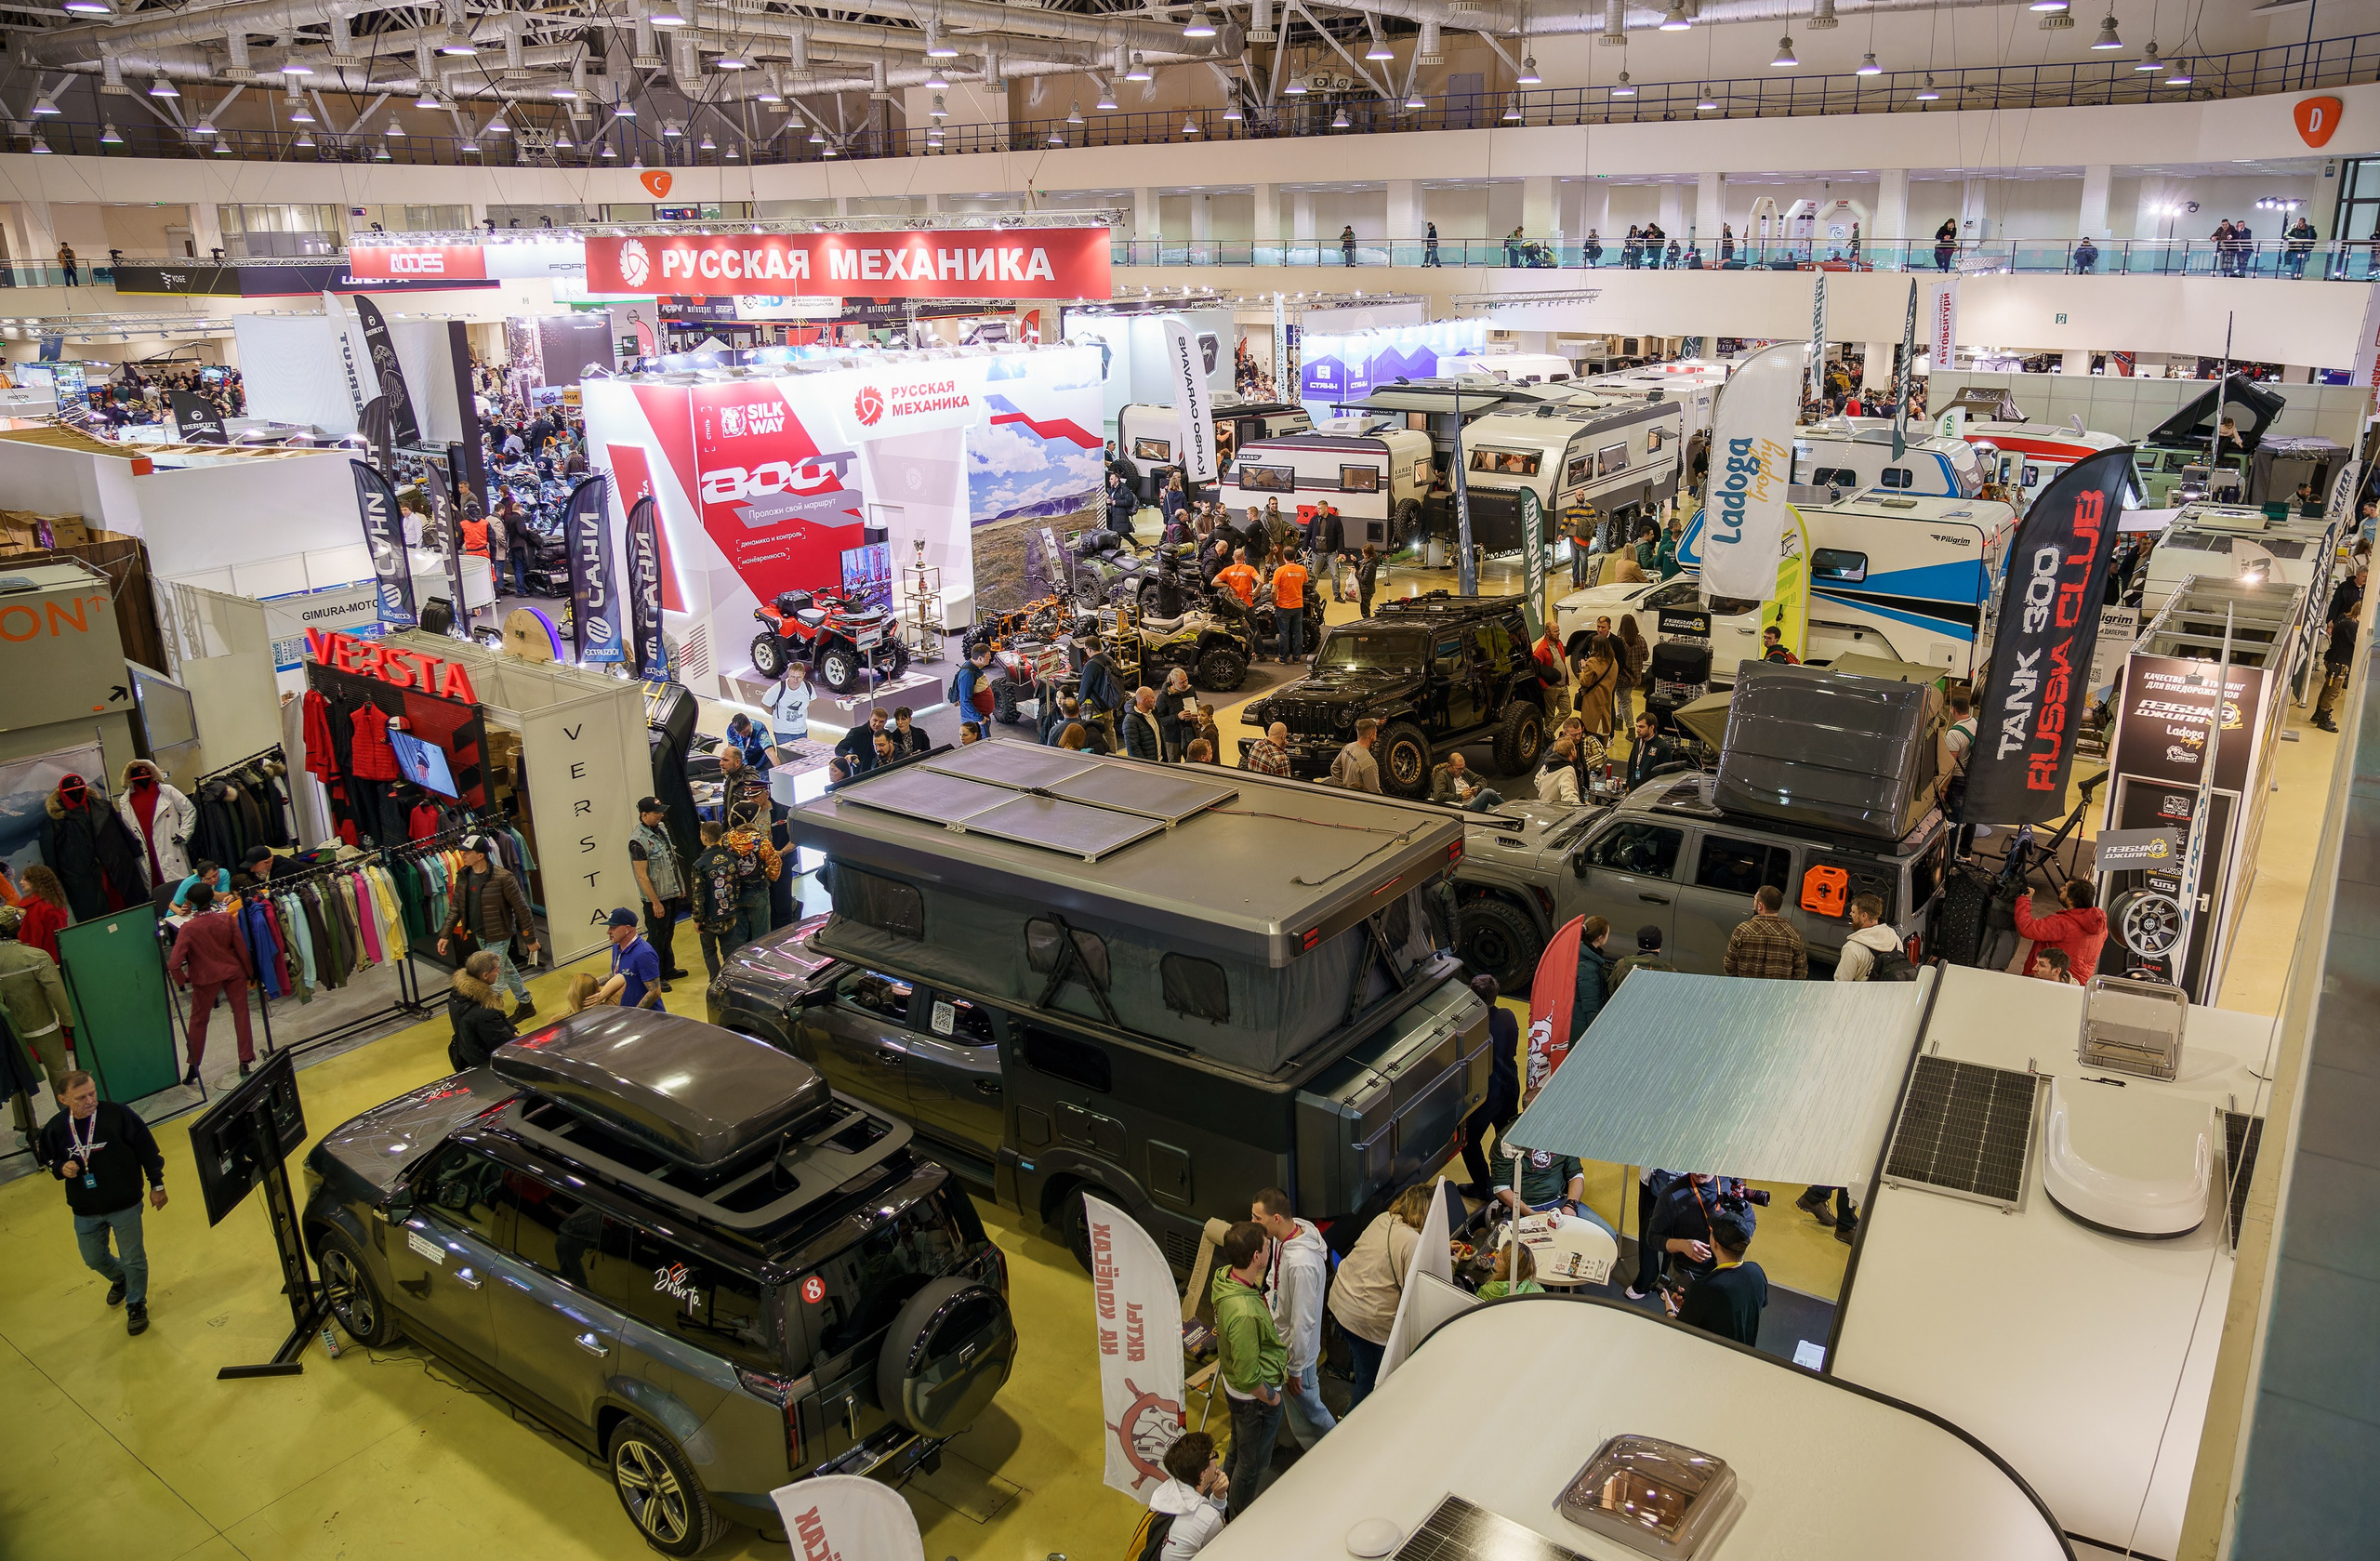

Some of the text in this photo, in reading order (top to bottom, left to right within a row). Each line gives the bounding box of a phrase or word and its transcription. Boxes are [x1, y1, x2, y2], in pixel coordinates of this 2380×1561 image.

[2309, 108, 2323, 132] D
[661, 247, 1055, 282] РУССКАЯ МЕХАНИКА
[172, 274, 186, 284] VOGE
[892, 380, 955, 399] РУССКАЯ
[747, 402, 784, 419] SILK
[892, 395, 971, 417] МЕХАНИКА
[1698, 396, 1710, 405] 100%
[181, 421, 218, 431] BERKUT
[751, 418, 786, 435] WAY
[1395, 466, 1412, 476] KARSO
[1744, 437, 1789, 503] trophy
[1712, 437, 1761, 544] Ladoga
[748, 497, 837, 521] Проложи свой маршрут
[741, 535, 771, 549] динамика
[776, 529, 803, 543] контроль
[1940, 535, 1971, 546] Piligrim
[583, 512, 604, 607] САНИ
[741, 549, 787, 565] манёвренность
[302, 599, 378, 622] GIMURA-MOTO
[1664, 617, 1702, 627] АЗБУКА
[2027, 489, 2106, 791] RUSSIA CLUB
[1997, 547, 2060, 761] TANK 300
[305, 628, 478, 705] VERSTA
[2146, 681, 2164, 690] ДЛЯ
[2134, 708, 2206, 724] ДЖИПА
[2166, 724, 2204, 741] Ladoga
[563, 723, 608, 926] VERSTA
[2106, 844, 2162, 853] АЗБУКА
[654, 1266, 687, 1297] Drive
[806, 1279, 822, 1299] 8
